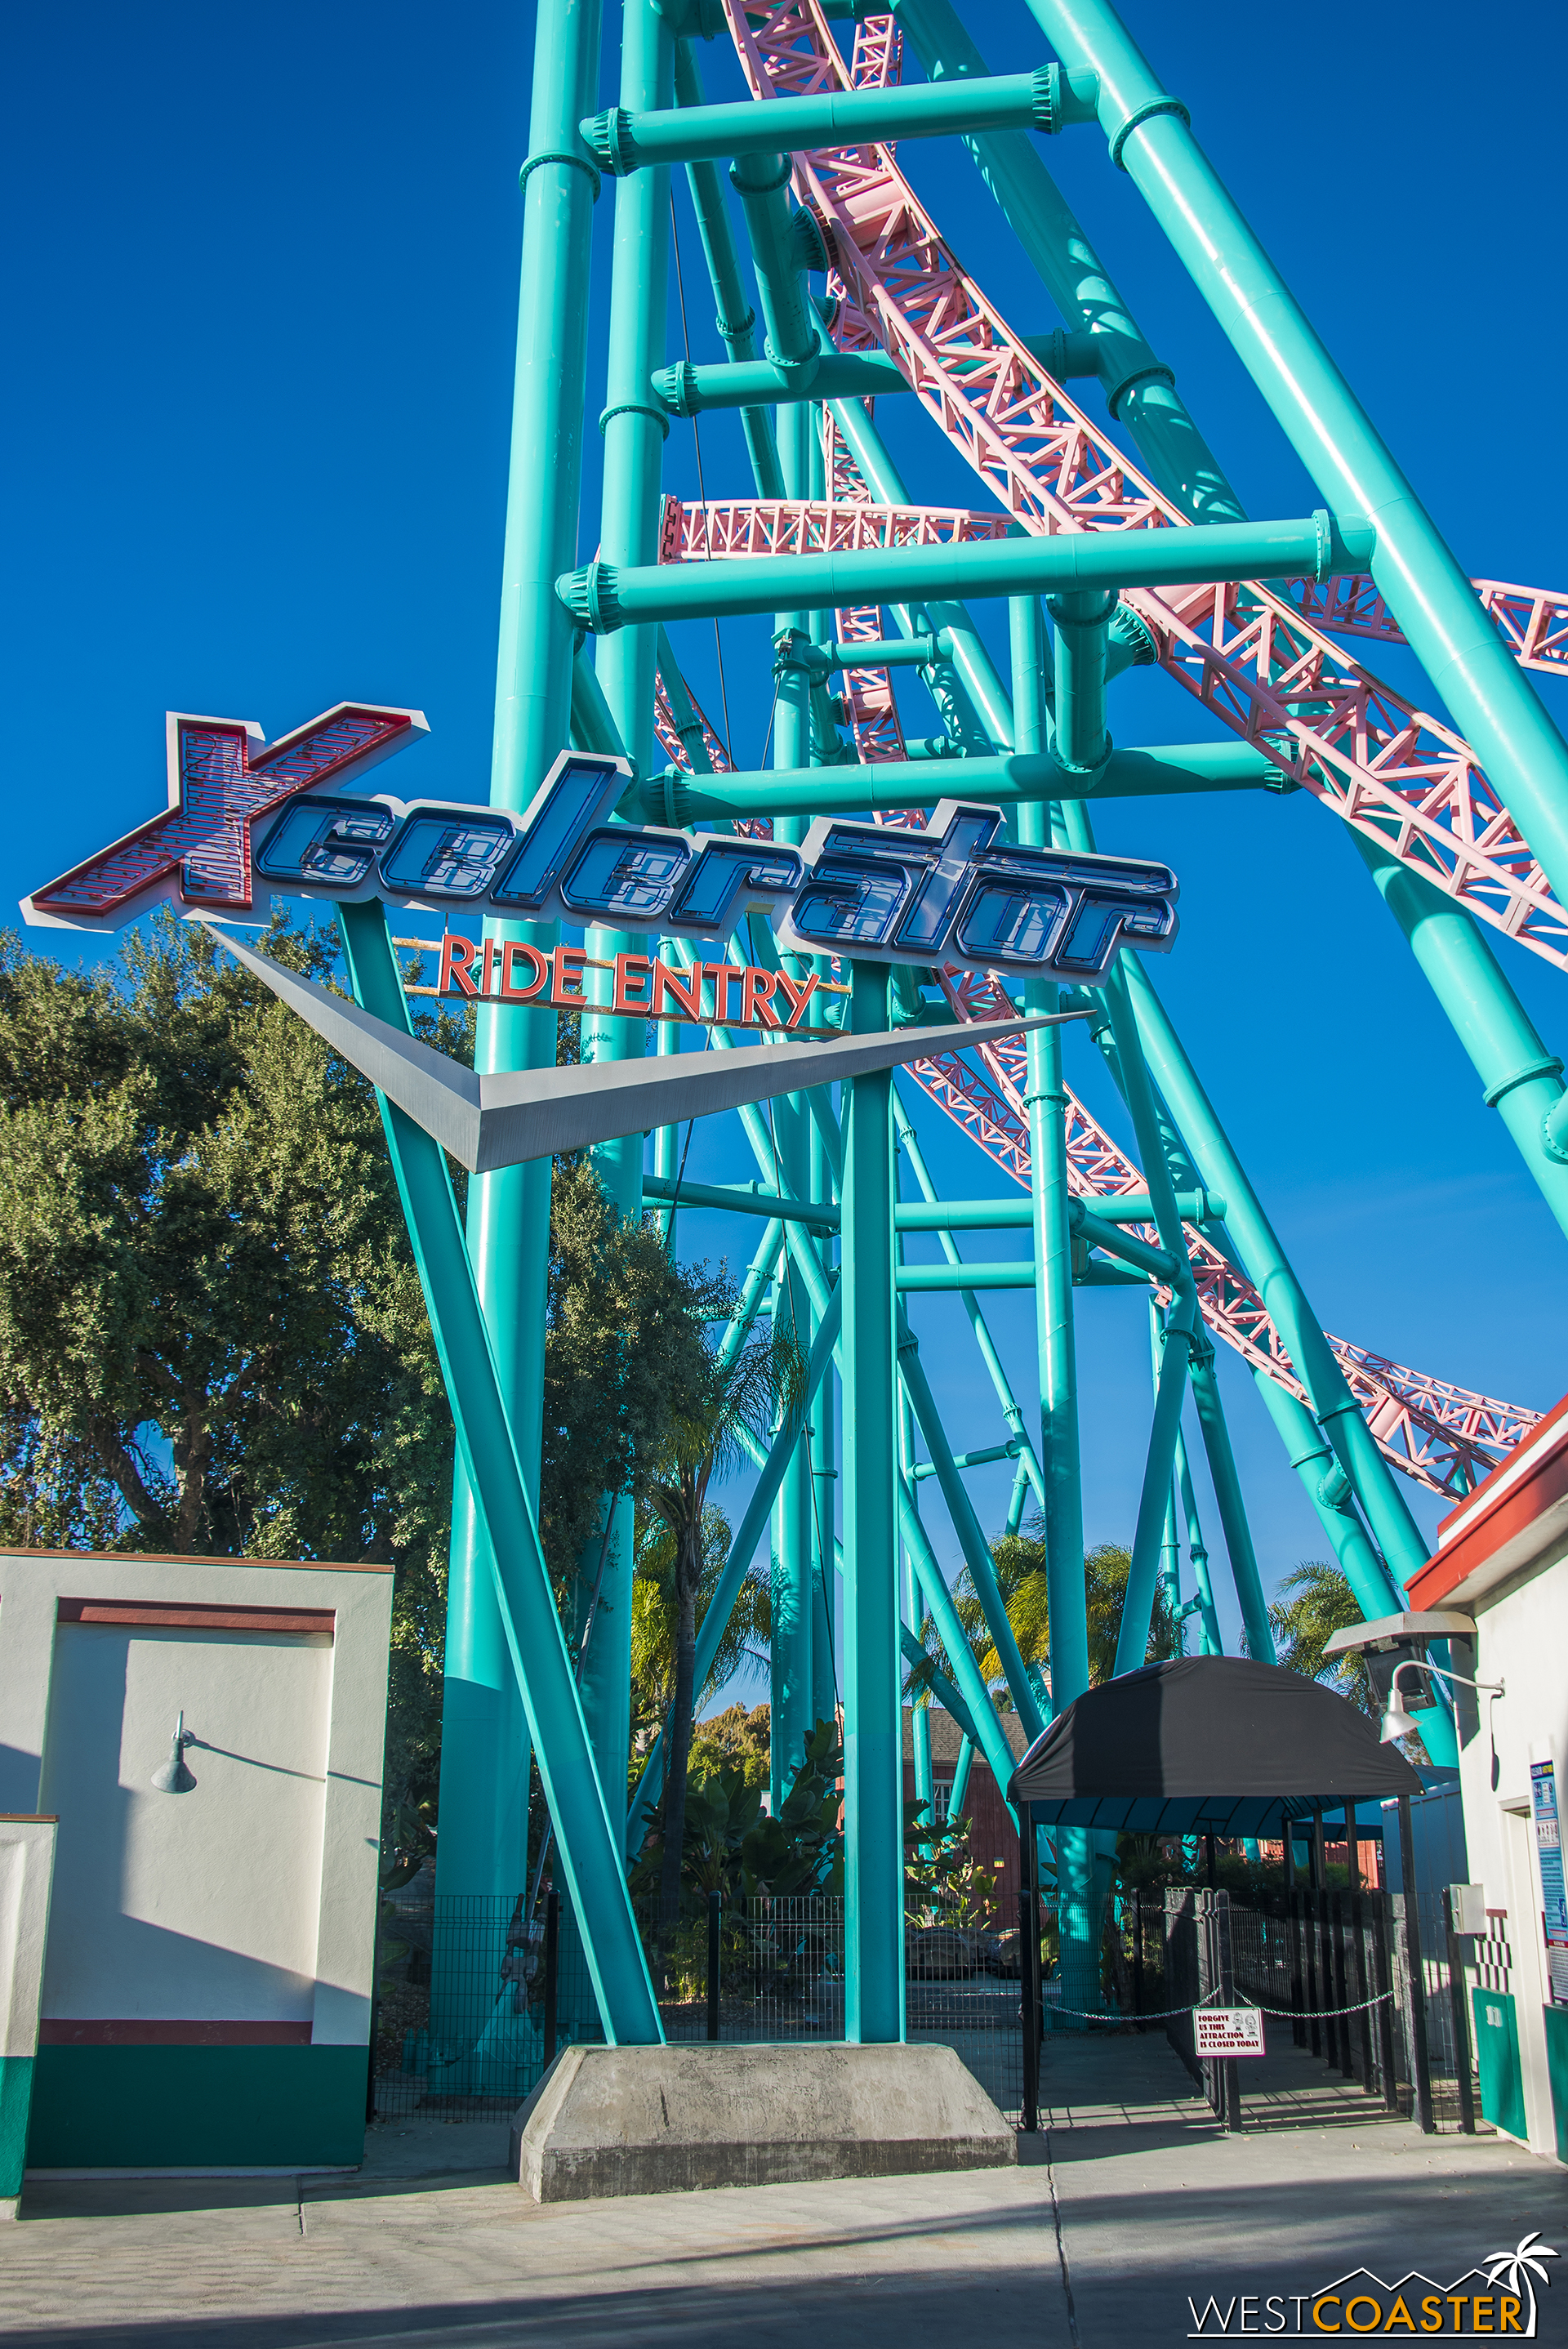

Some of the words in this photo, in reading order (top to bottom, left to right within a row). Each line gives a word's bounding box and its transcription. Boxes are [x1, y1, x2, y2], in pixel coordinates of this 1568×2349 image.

[26, 704, 1178, 976] Xcelerator
[438, 934, 588, 1011] RIDE
[612, 952, 821, 1033] ENTRY
